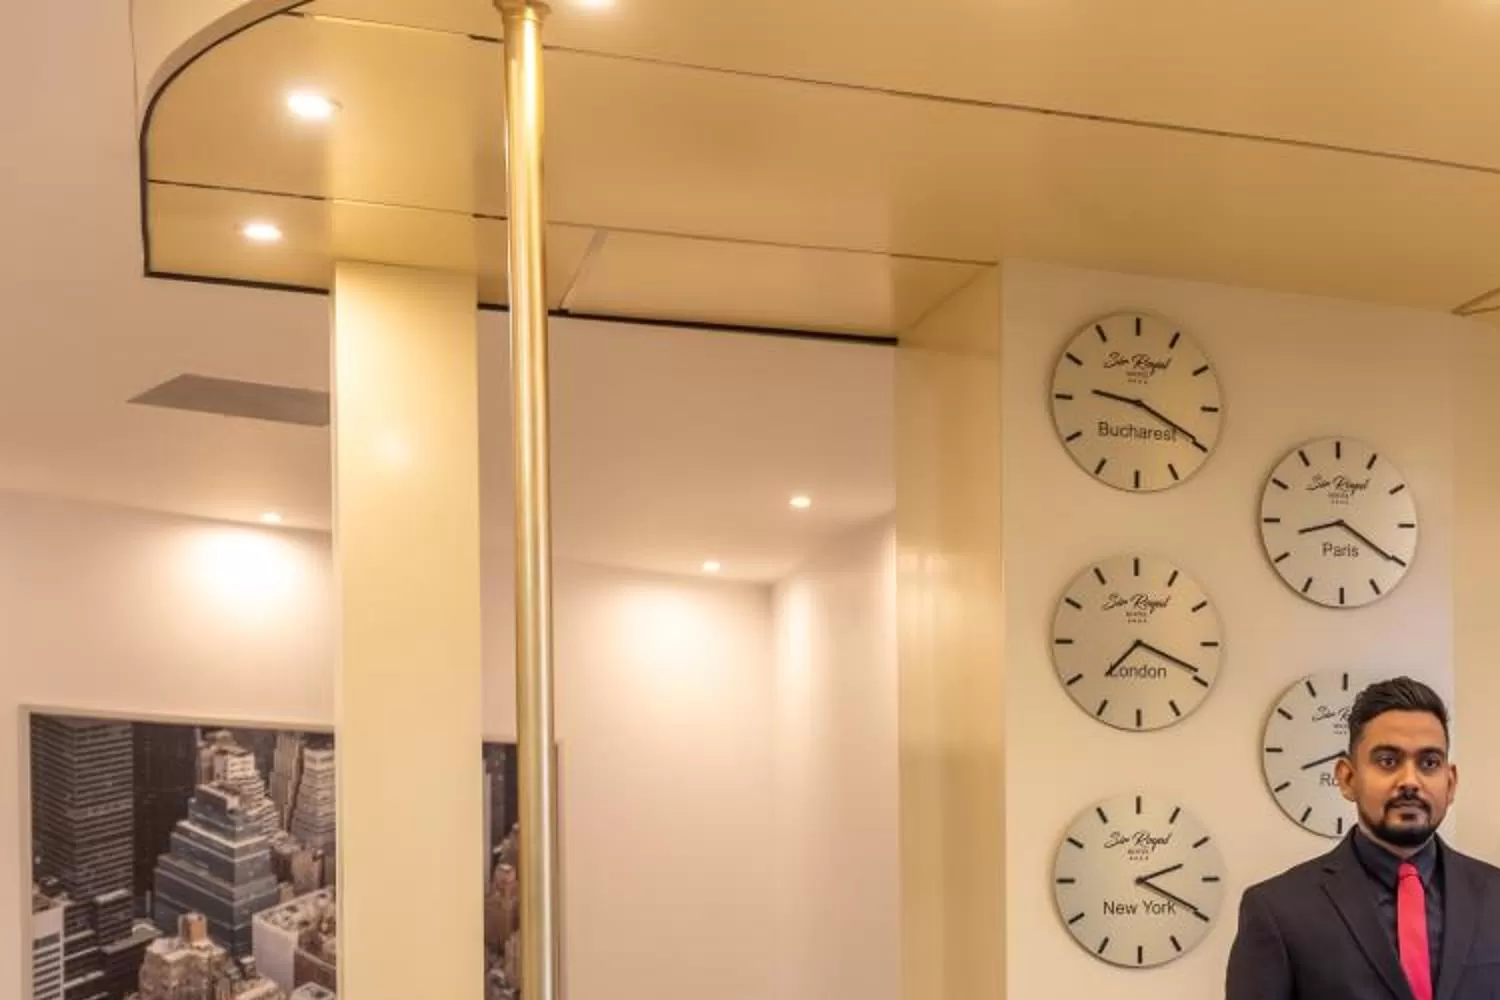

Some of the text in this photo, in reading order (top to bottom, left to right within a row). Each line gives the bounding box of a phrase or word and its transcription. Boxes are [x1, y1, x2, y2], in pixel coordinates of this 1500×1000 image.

[1097, 421, 1177, 442] Bucharest
[1322, 542, 1360, 558] Paris
[1109, 662, 1168, 679] London
[1103, 899, 1177, 916] New York
